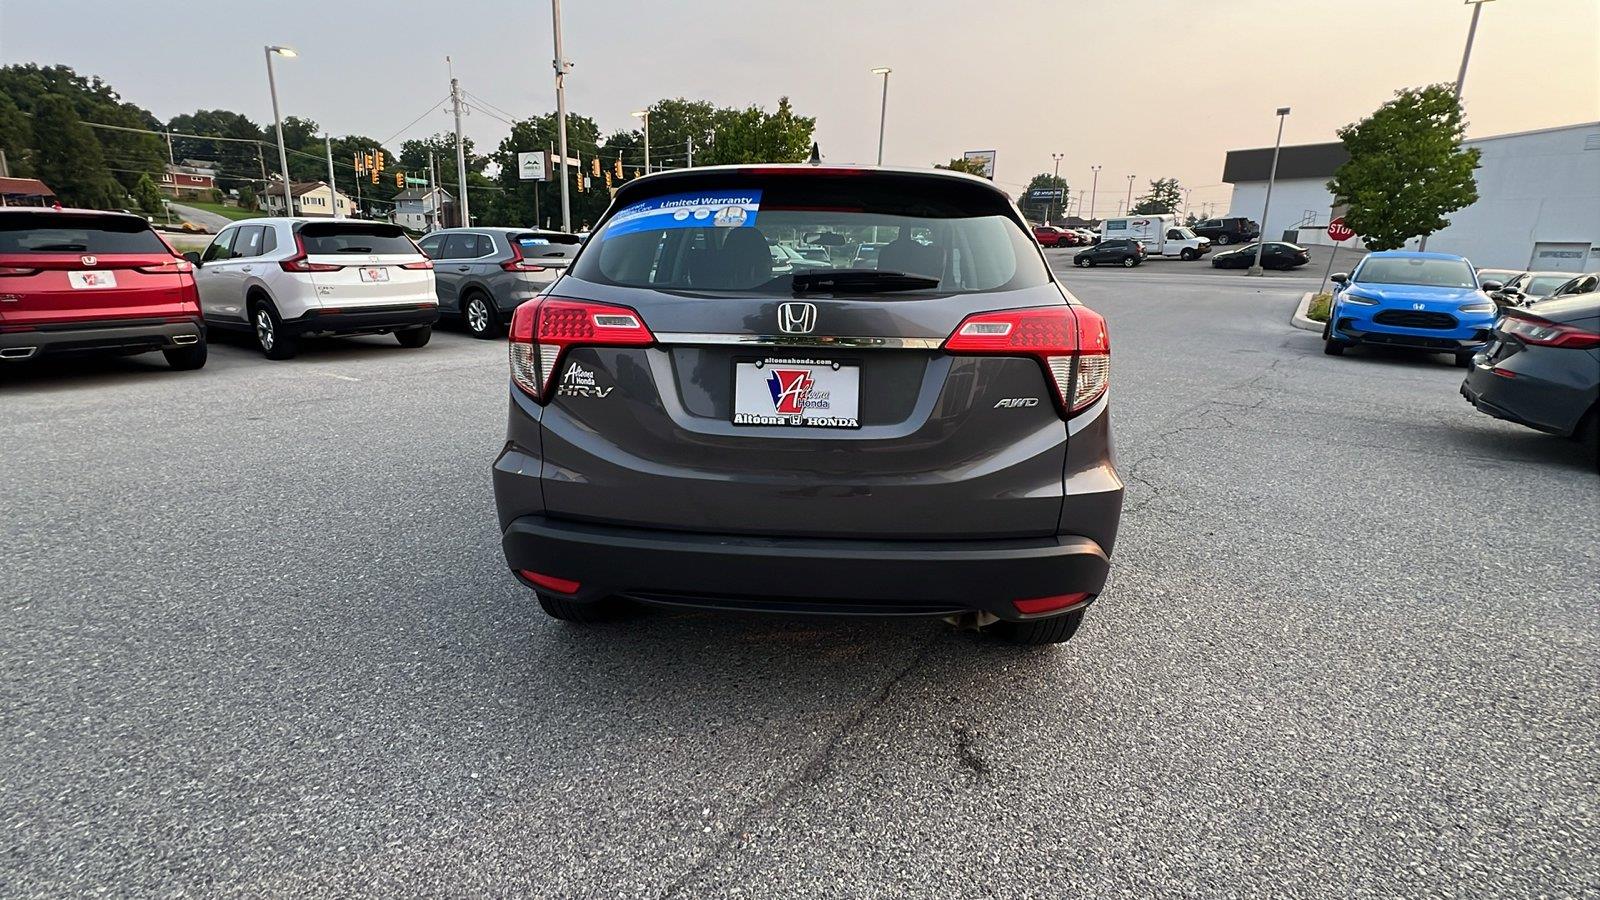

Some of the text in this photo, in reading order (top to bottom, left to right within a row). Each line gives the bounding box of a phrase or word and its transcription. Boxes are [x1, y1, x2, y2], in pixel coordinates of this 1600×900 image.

[660, 196, 753, 209] Limited Warranty
[764, 357, 832, 365] altoonahonda.com
[576, 377, 595, 386] Honda
[557, 385, 614, 398] HR-V
[797, 399, 830, 409] Honda
[993, 397, 1039, 409] AWD
[733, 413, 859, 427] Altoona HONDA
